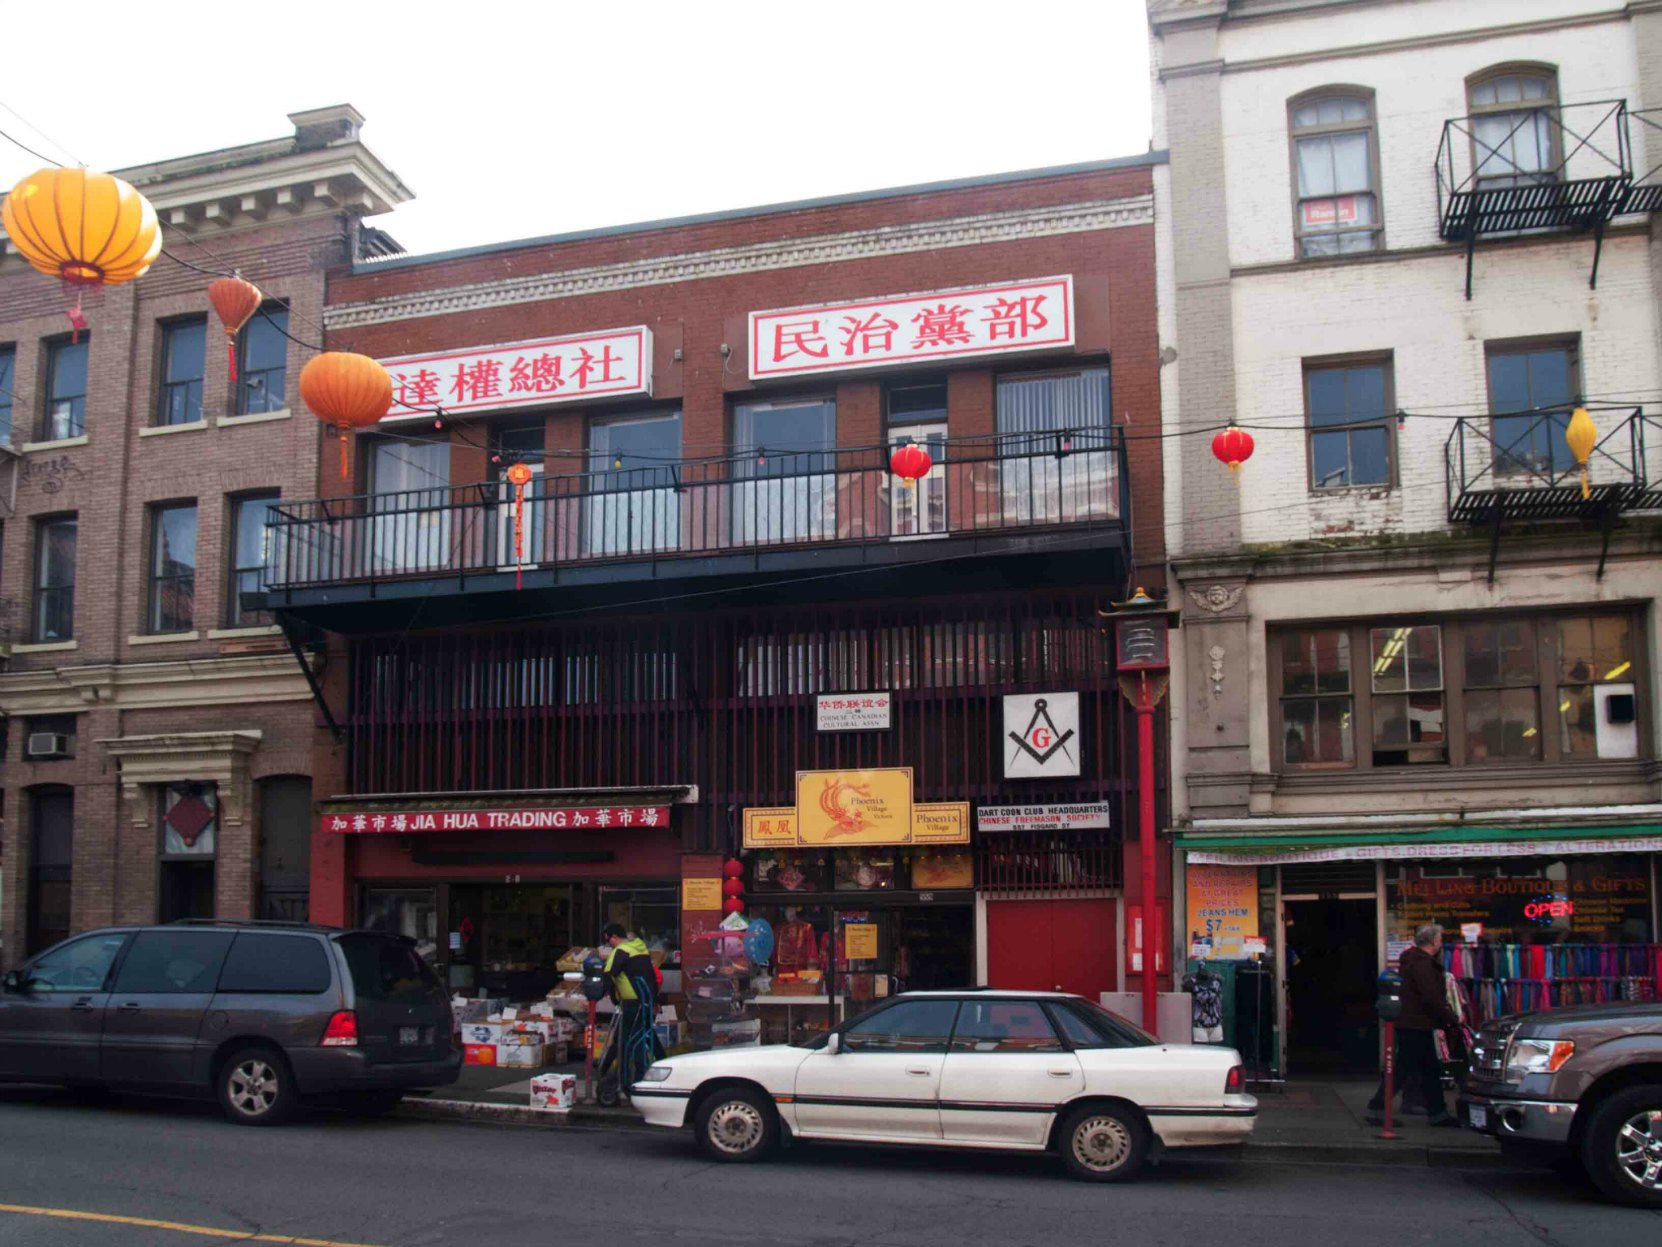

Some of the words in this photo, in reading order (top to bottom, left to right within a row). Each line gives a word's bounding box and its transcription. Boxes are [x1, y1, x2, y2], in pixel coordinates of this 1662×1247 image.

[772, 294, 1050, 362] 民治黨部
[1032, 727, 1051, 748] G
[979, 809, 999, 817] DART
[1001, 808, 1021, 816] COON
[1024, 807, 1044, 815] CLUB
[1048, 805, 1108, 814] HEADQUARTERS
[410, 815, 436, 829] JIA
[443, 813, 479, 829] HUA
[487, 811, 567, 828] TRADING
[916, 814, 958, 824] Phoenix
[979, 816, 1011, 824] CHINESE
[1015, 814, 1061, 823] FREEMASON
[757, 820, 791, 835] 鳳凰
[926, 824, 949, 832] Village
[1524, 901, 1573, 918] OPEN
